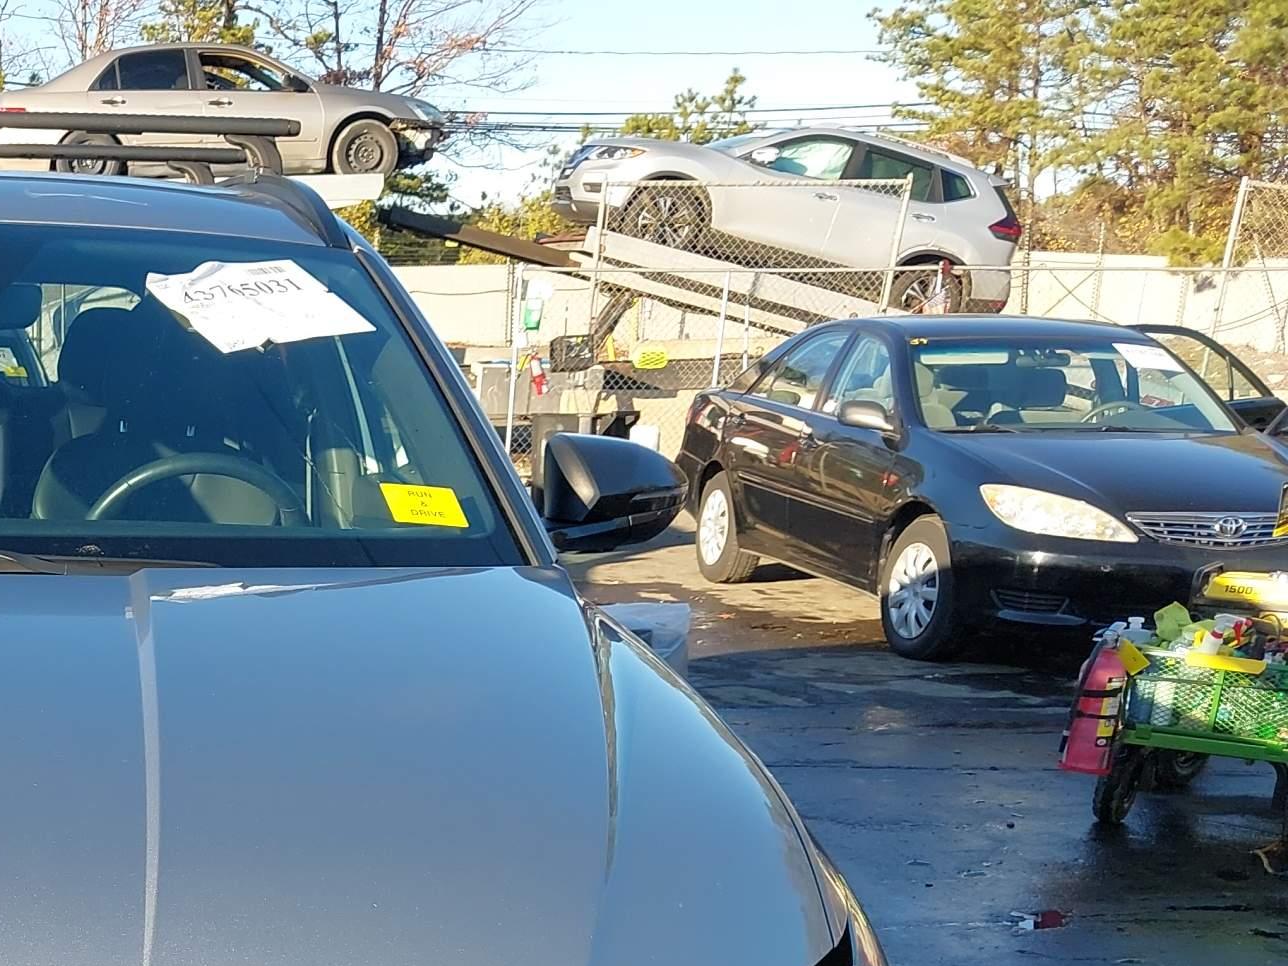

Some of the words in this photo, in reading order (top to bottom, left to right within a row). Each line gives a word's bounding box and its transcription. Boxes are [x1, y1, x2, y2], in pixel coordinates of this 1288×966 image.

[184, 279, 303, 303] 43765031
[408, 490, 432, 498] RUN
[411, 509, 446, 518] DRIVE
[1224, 585, 1253, 595] 1500
